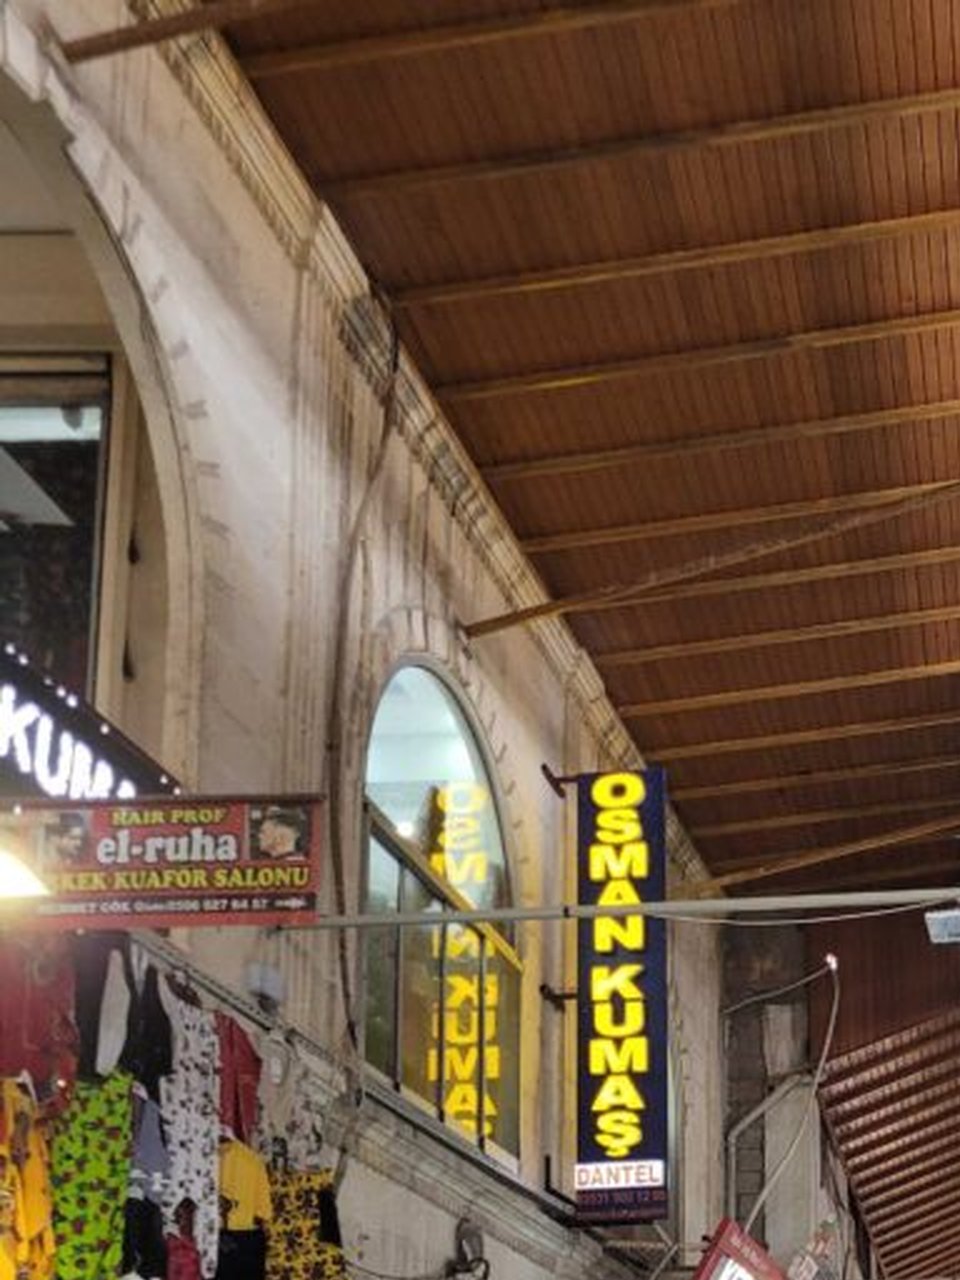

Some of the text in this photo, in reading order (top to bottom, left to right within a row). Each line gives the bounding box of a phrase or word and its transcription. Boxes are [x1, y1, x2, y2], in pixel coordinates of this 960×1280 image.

[112, 808, 227, 826] HAIR PROF
[589, 772, 649, 953] OSMAN
[214, 867, 309, 889] SALONU
[589, 963, 649, 1157] KUMAŞ
[577, 1164, 661, 1186] DANTEL
